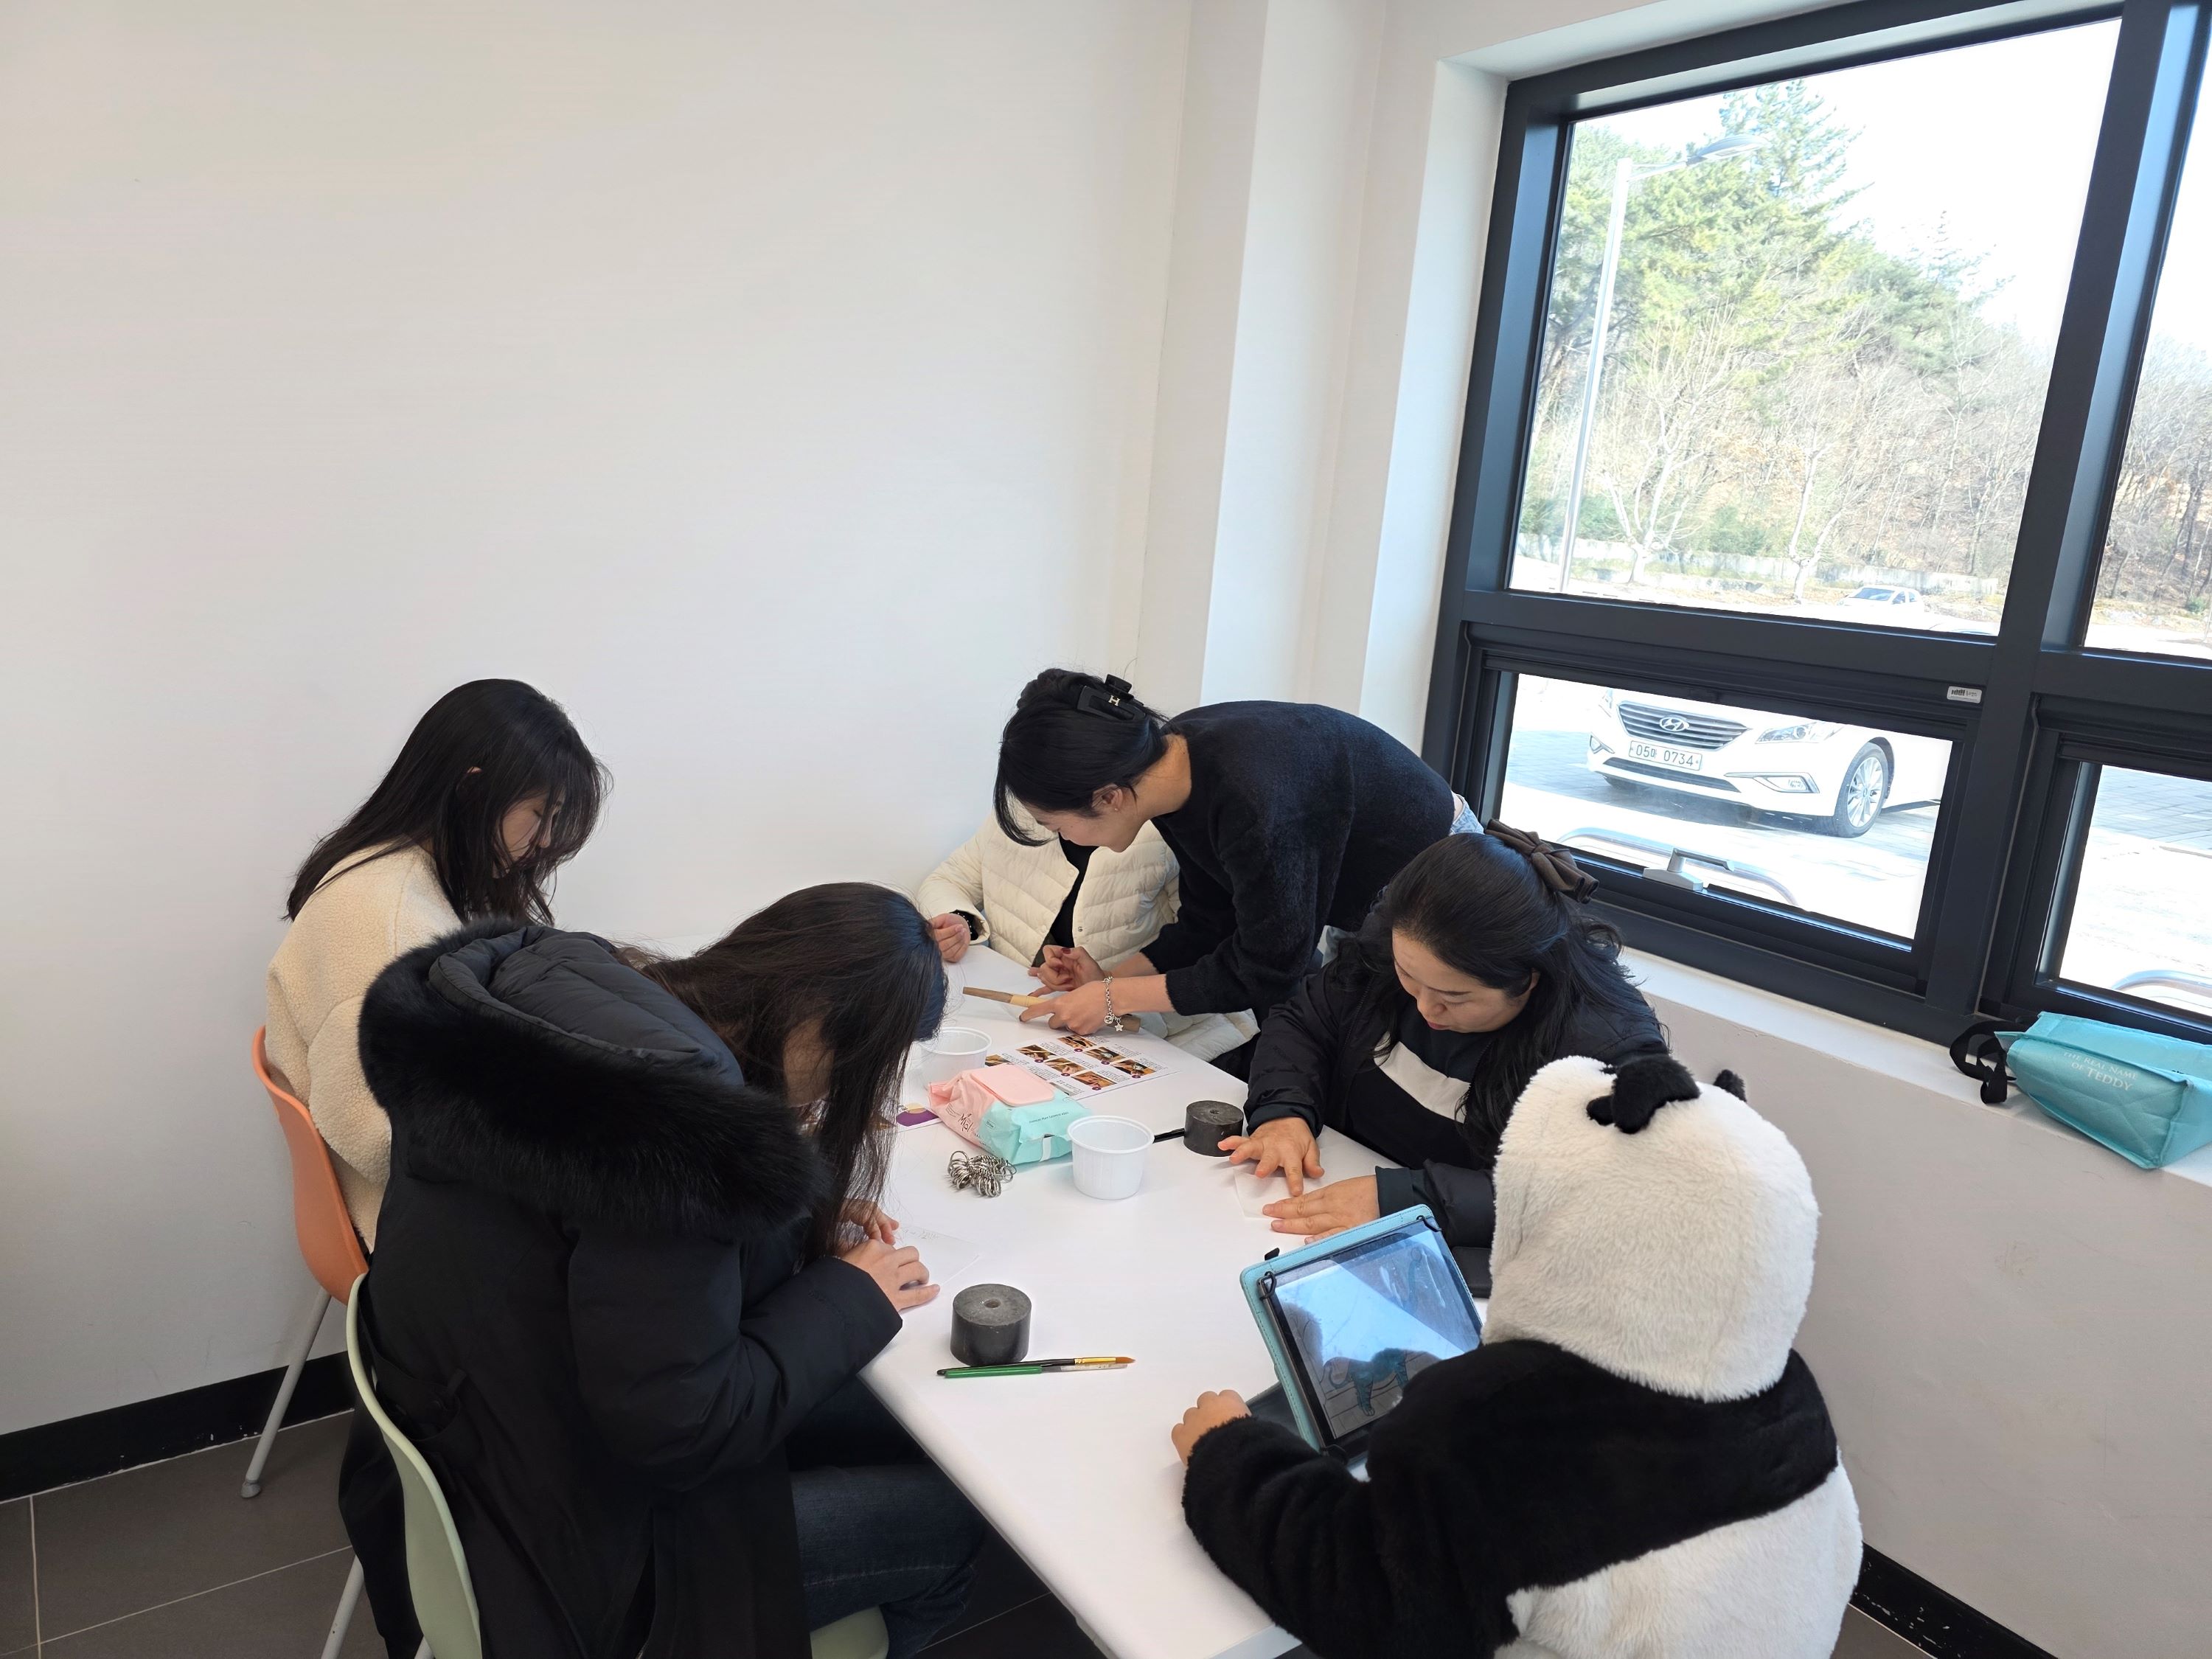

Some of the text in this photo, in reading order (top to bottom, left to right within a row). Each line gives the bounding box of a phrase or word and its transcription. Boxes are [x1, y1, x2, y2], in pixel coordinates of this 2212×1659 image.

[1663, 750, 1694, 767] 0734
[2064, 1051, 2138, 1080] THE REAL NAME
[2071, 1062, 2133, 1091] OF TEDDY
